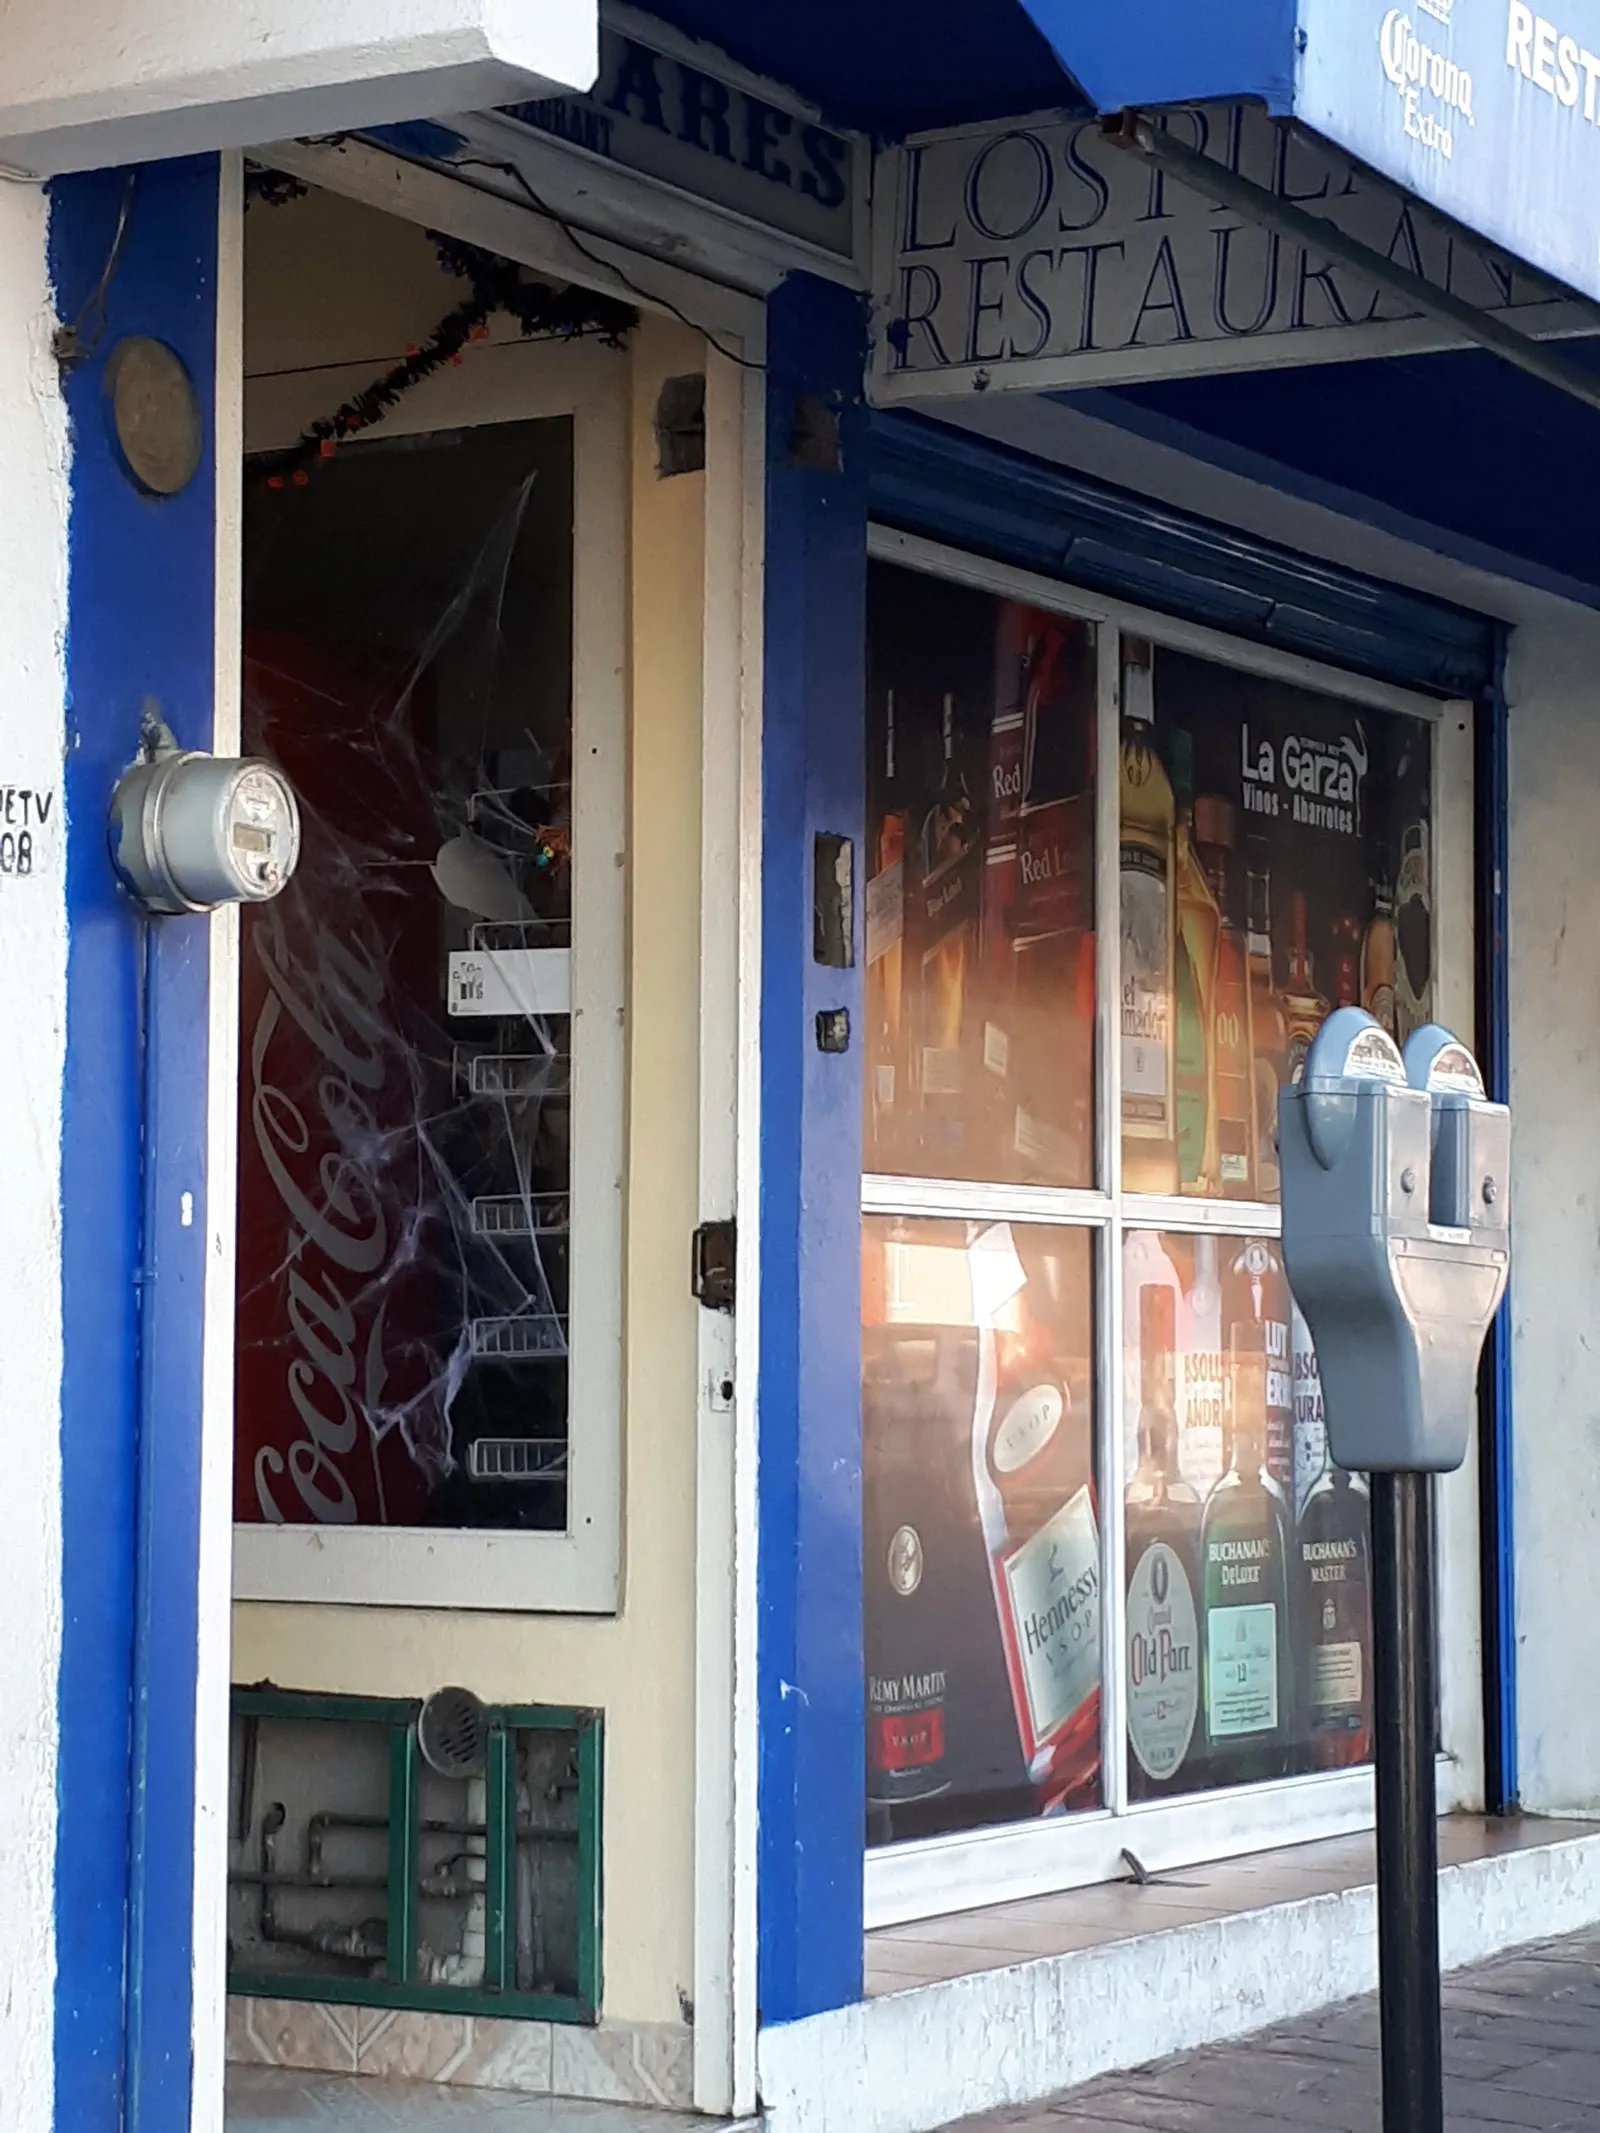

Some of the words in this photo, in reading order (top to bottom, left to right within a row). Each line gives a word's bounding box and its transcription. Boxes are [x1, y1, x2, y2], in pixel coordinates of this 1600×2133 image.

[1380, 8, 1475, 127] Corona
[1506, 0, 1600, 126] REST
[1403, 85, 1453, 160] Extra
[900, 128, 1110, 254] LOS
[992, 761, 1022, 799] Red
[1241, 722, 1275, 783] La
[1281, 734, 1355, 804] Garza
[0, 788, 54, 827] ETV
[1242, 781, 1280, 817] Vinos
[1292, 793, 1354, 835] Abarrotes
[1020, 847, 1052, 885] Red
[1130, 1631, 1158, 1687] Old
[1159, 1628, 1193, 1684] Parr
